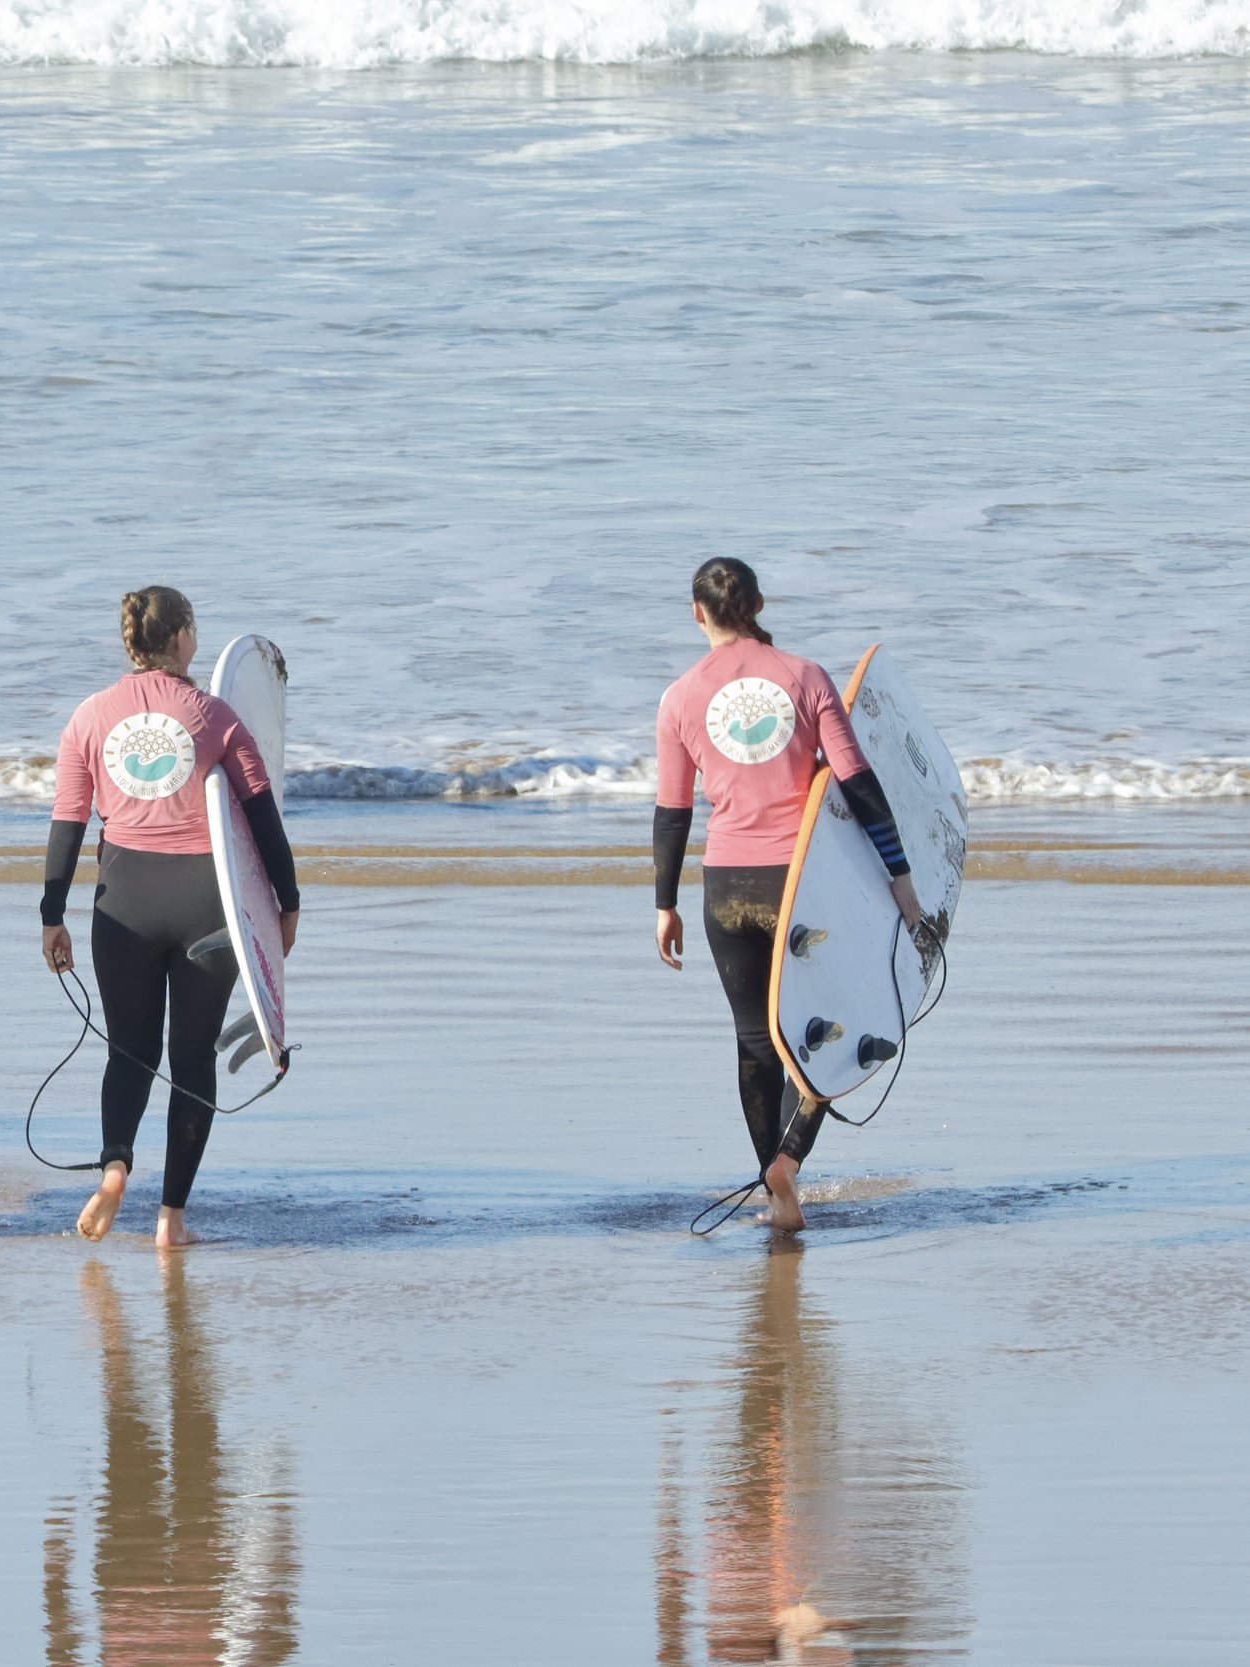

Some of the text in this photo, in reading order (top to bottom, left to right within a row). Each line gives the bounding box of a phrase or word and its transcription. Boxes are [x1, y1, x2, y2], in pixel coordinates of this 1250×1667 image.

[116, 769, 187, 797] LOCAL SURF MAROC
